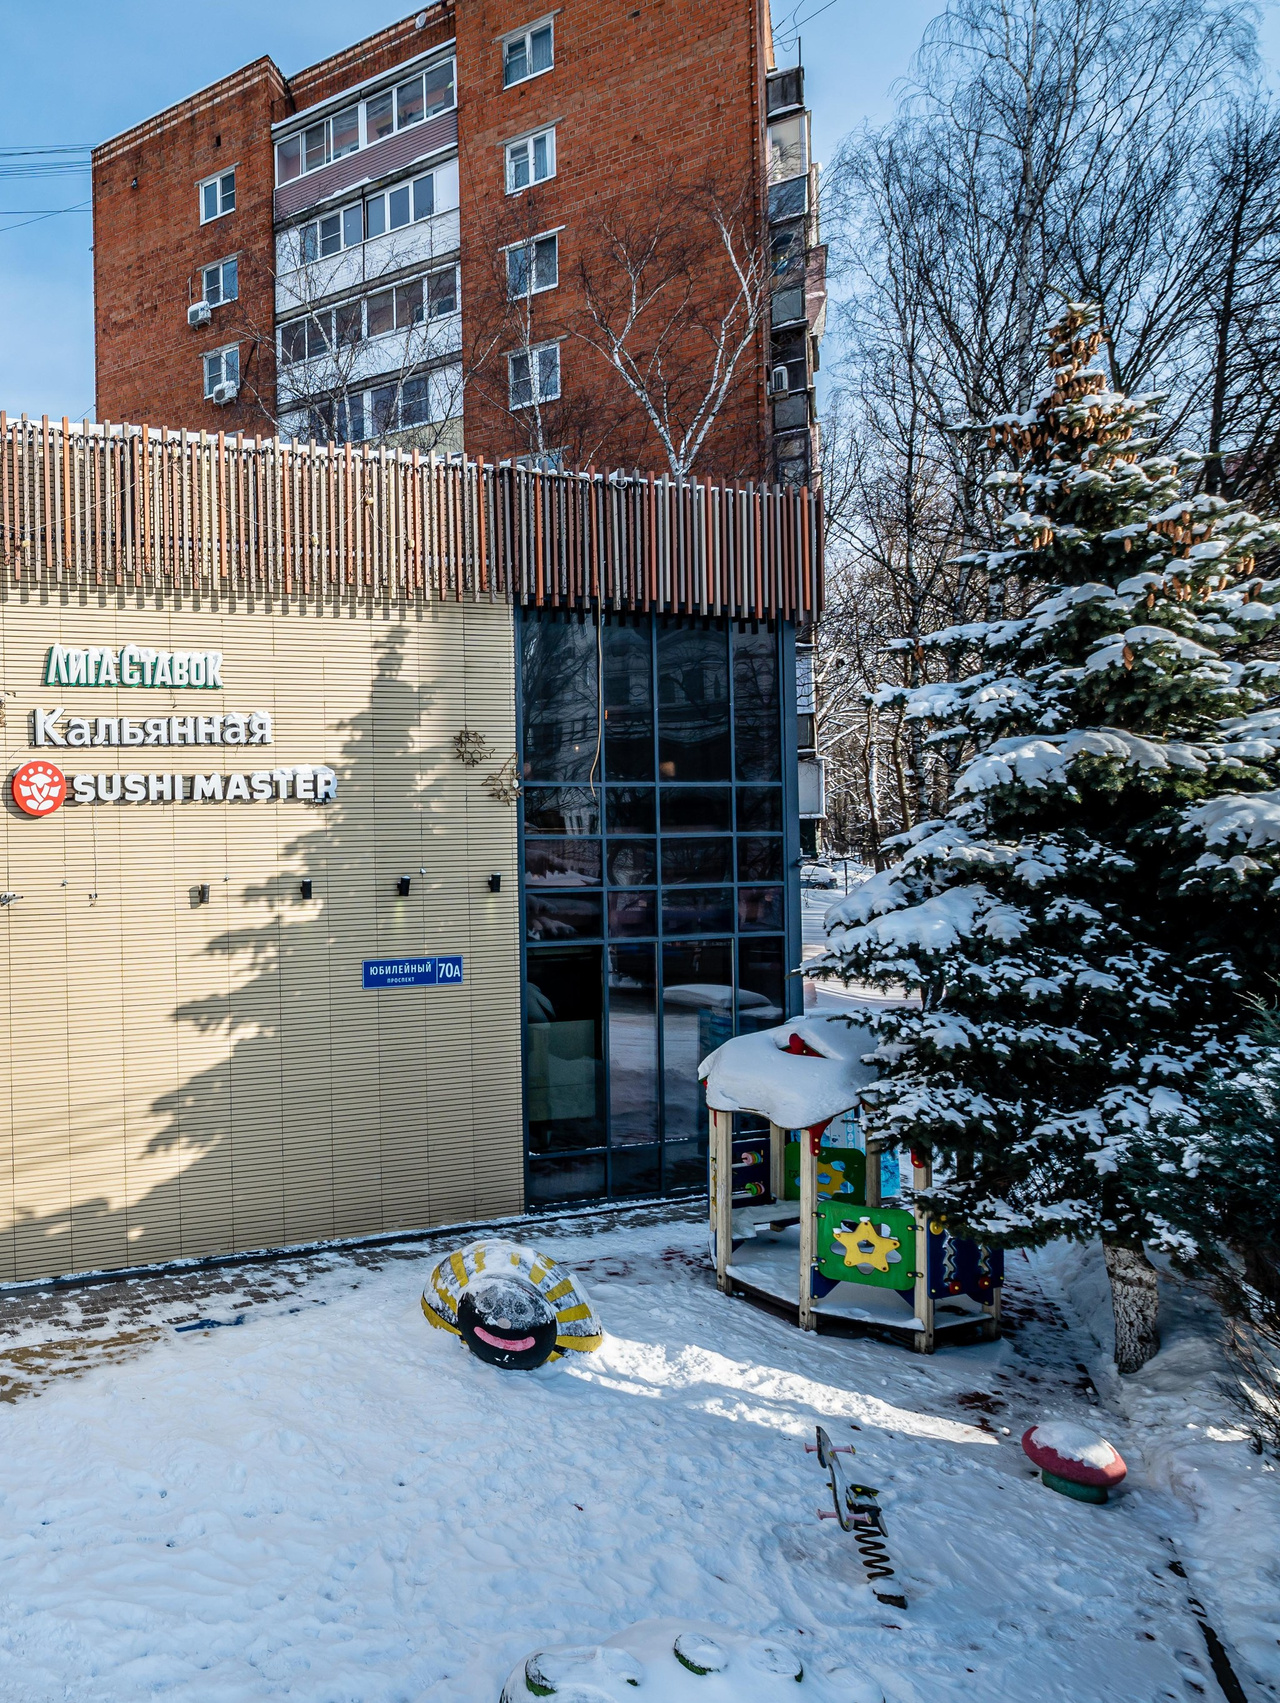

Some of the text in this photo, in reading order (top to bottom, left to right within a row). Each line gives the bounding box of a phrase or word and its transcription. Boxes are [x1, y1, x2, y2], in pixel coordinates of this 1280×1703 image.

[33, 707, 273, 746] Кальянная
[72, 765, 338, 803] SUSHI MASTER
[370, 961, 432, 976] ЮБИЛЕЙНЫЙ
